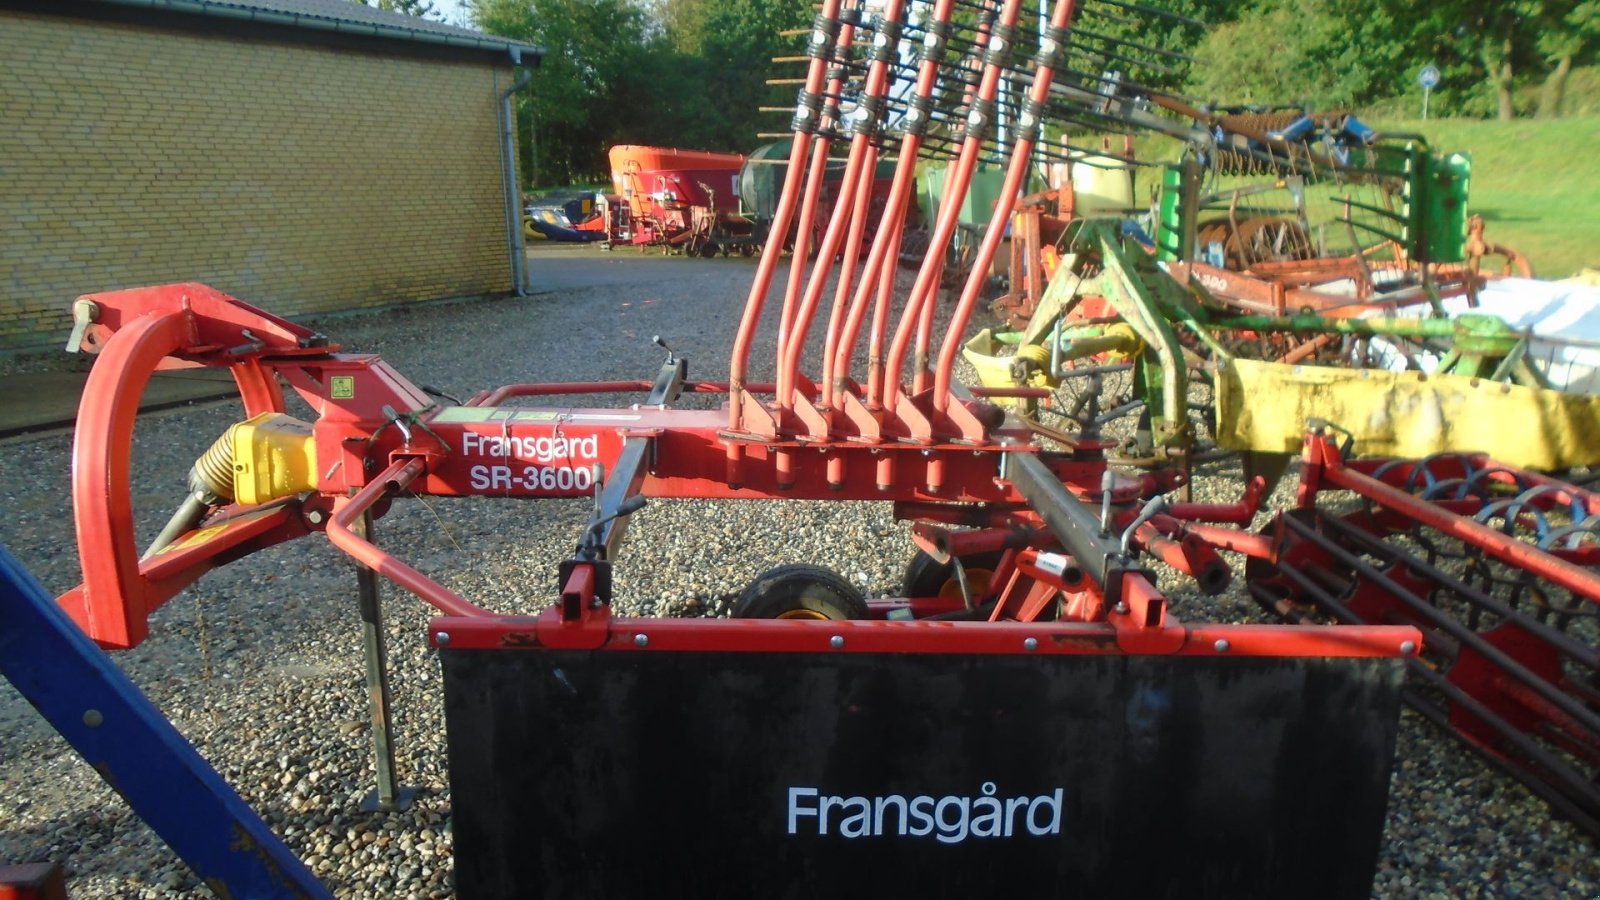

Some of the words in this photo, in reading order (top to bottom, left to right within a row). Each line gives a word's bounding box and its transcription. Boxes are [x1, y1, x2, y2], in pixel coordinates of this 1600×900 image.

[462, 431, 598, 461] Fransgård
[470, 465, 590, 490] SR-3600
[788, 781, 1063, 843] Fransgård
